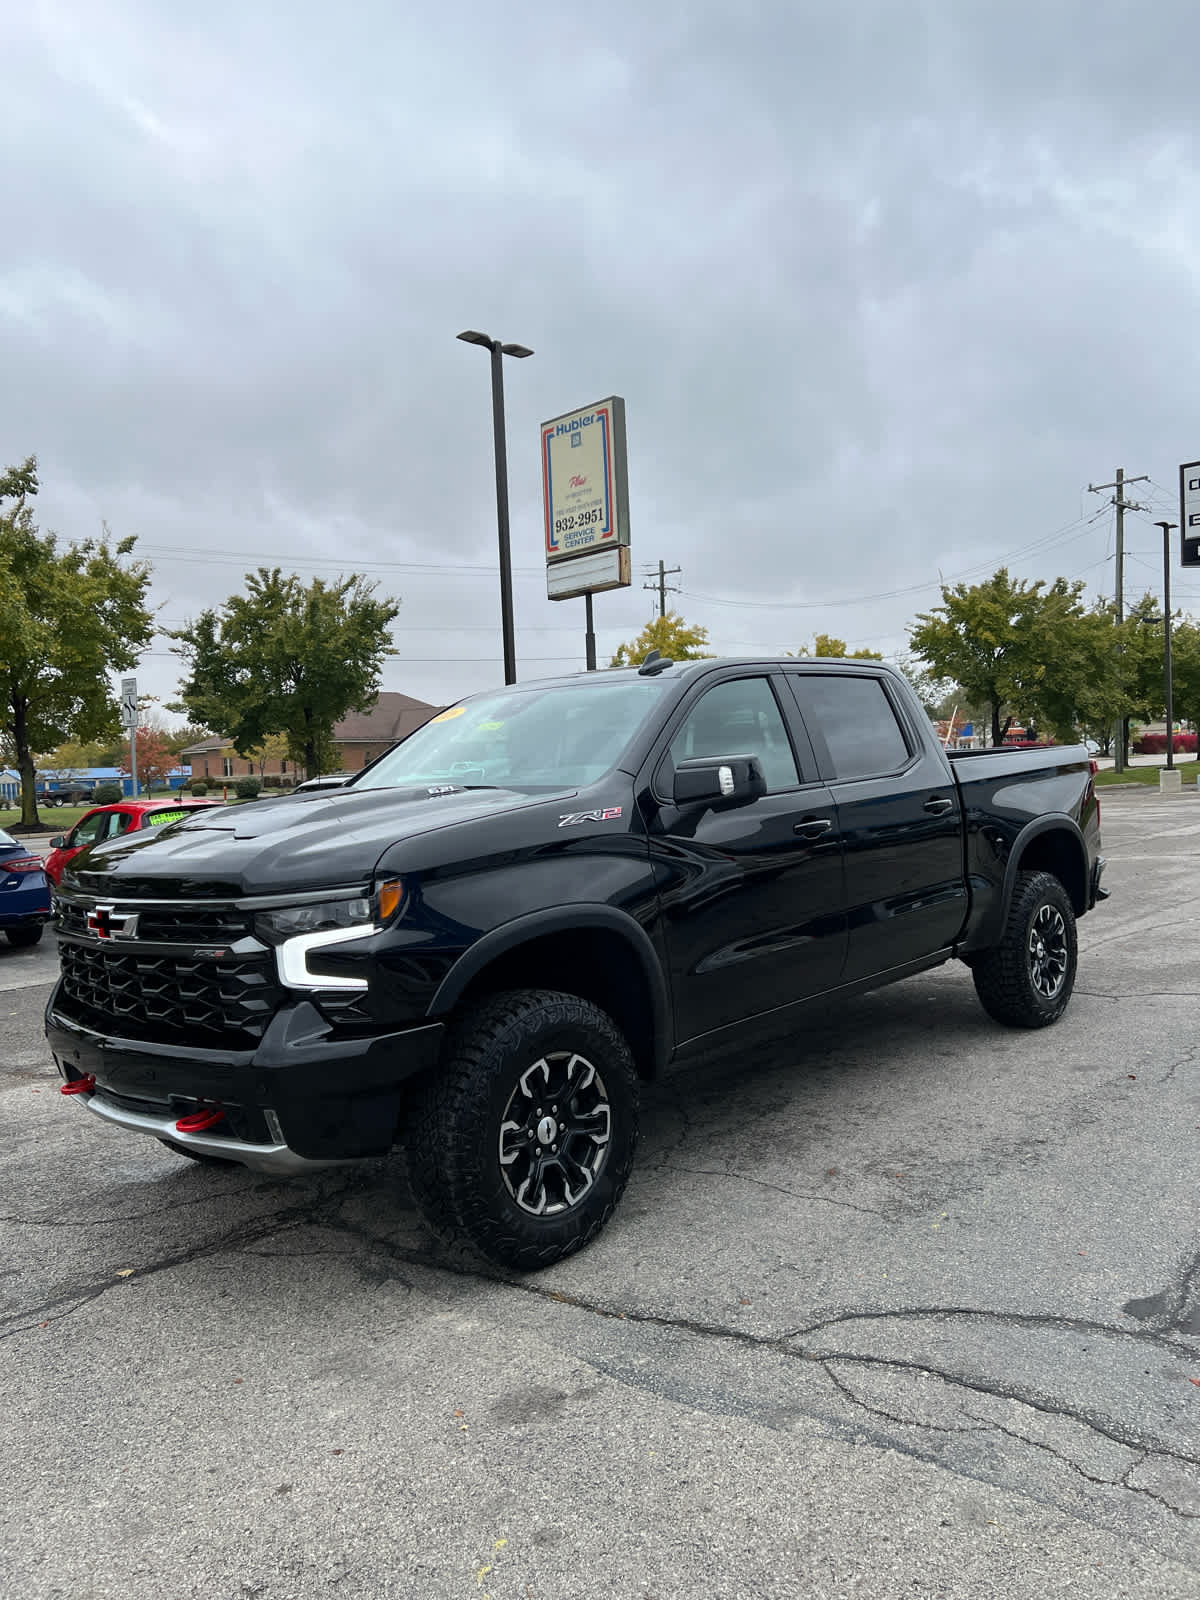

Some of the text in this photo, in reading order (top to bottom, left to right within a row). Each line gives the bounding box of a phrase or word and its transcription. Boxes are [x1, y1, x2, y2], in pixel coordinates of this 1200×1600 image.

[556, 414, 595, 436] Hubler
[555, 507, 604, 533] 932-2951
[563, 526, 595, 541] SERVICE
[564, 535, 595, 549] CENTER
